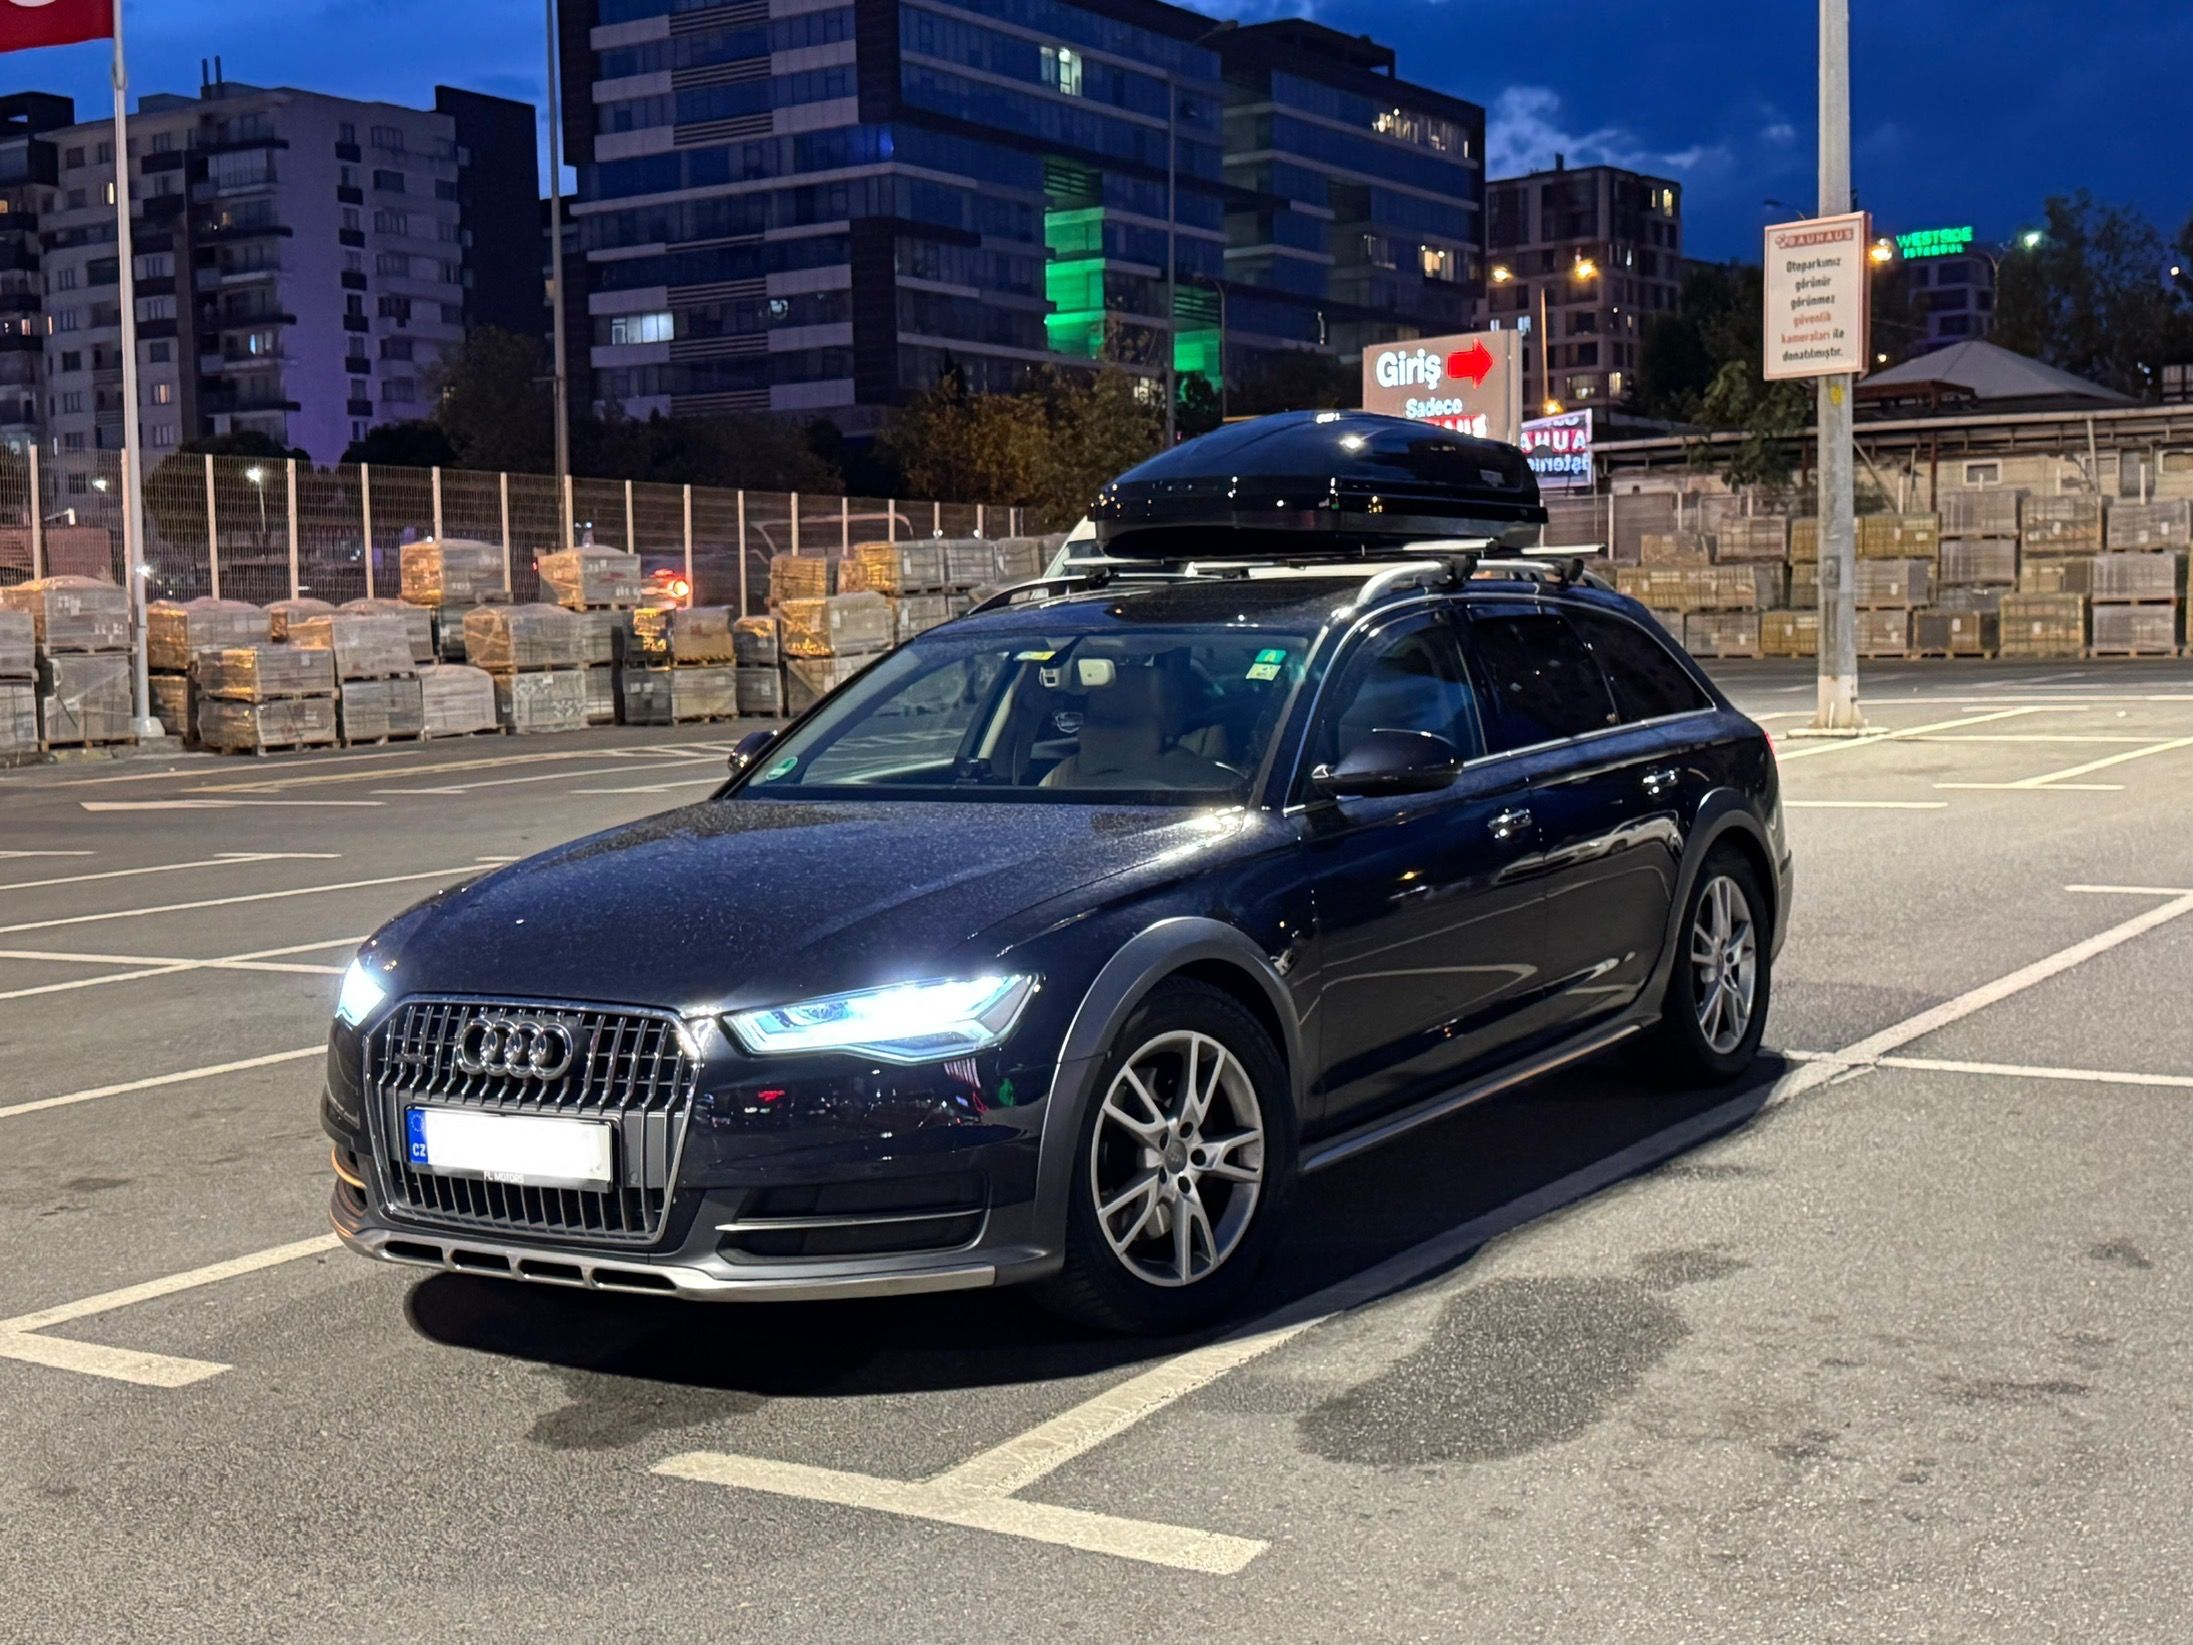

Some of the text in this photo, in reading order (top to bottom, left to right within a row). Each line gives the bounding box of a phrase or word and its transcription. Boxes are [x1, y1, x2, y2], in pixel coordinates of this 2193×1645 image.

[1786, 229, 1853, 247] BAUHAUS
[1896, 226, 1972, 248] WESTSIDE
[1786, 257, 1841, 273] Otoparkımız
[1795, 276, 1831, 292] görünür
[1791, 294, 1835, 310] görünmez
[1793, 311, 1831, 328] güvenlik
[1833, 328, 1844, 339] ile
[1376, 348, 1441, 390] Giriş
[1405, 397, 1463, 418] Sadece
[412, 1142, 426, 1157] CZ
